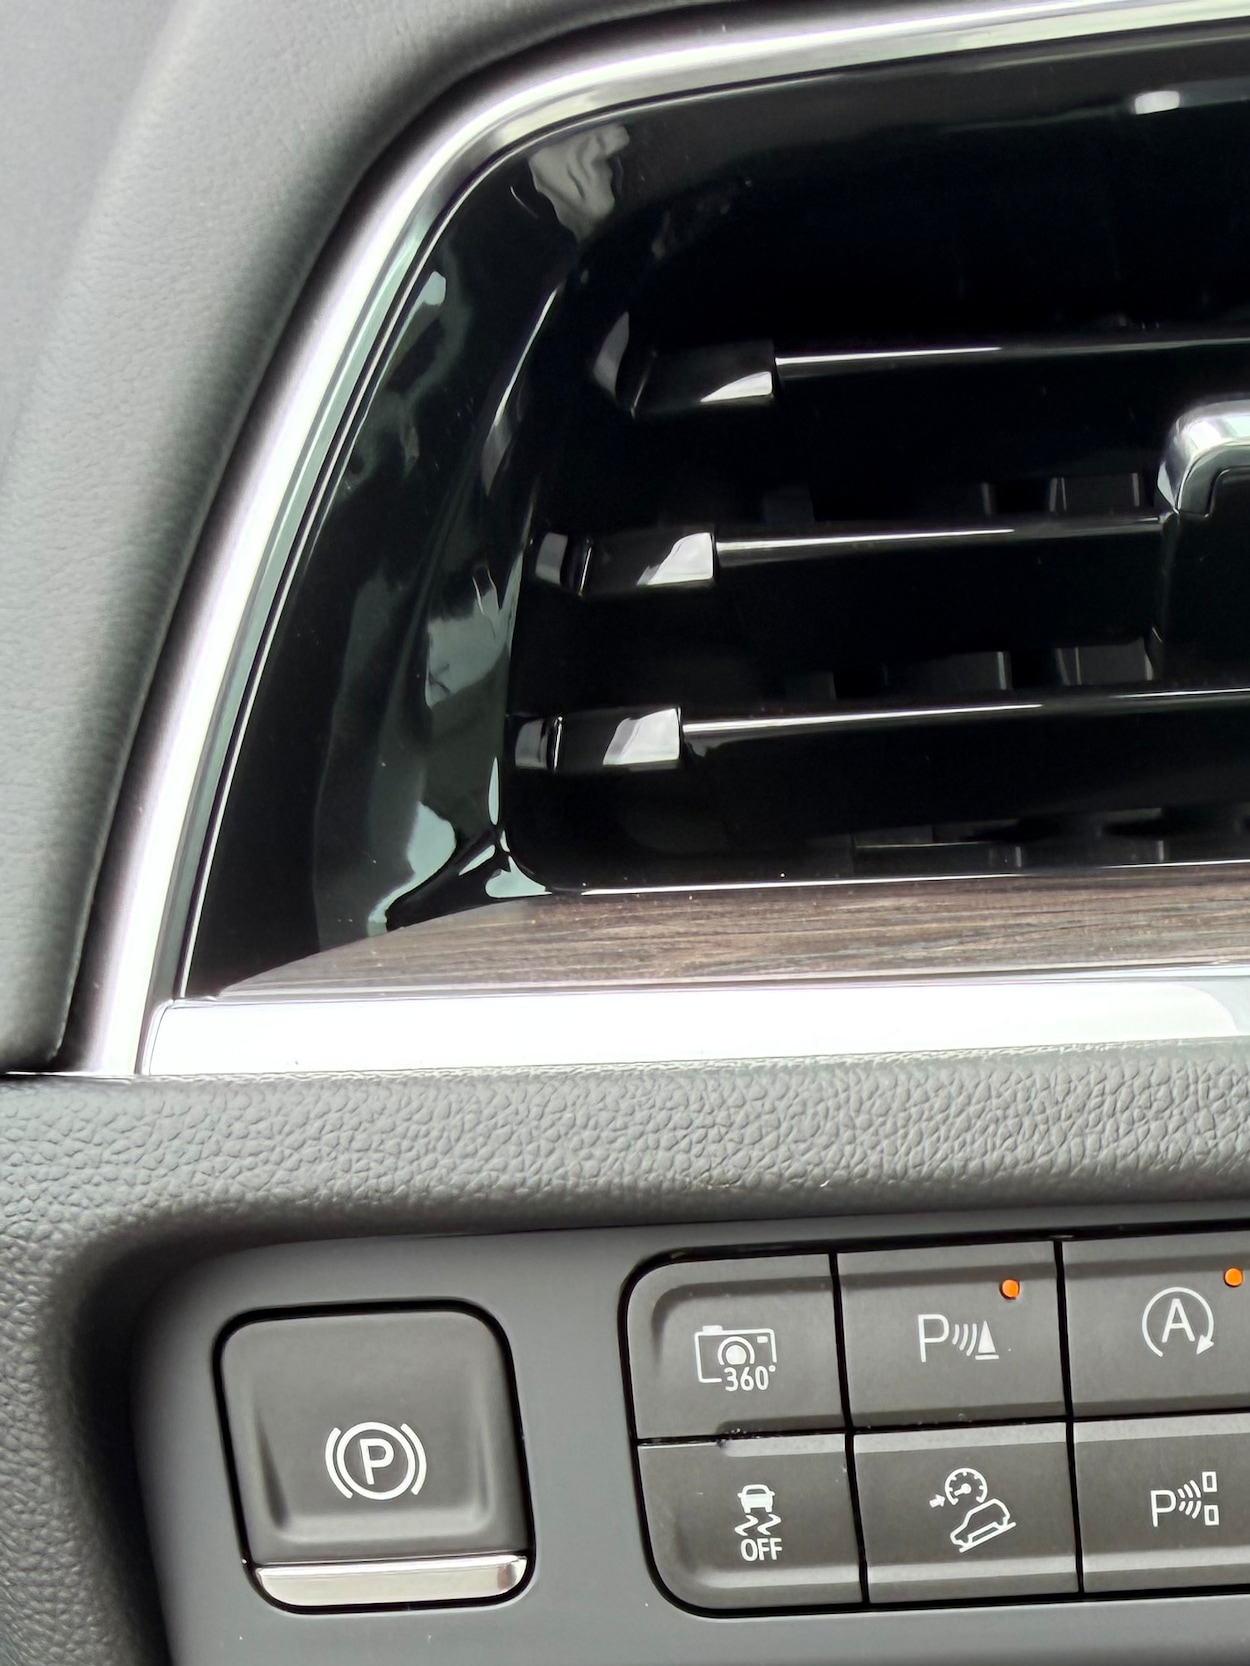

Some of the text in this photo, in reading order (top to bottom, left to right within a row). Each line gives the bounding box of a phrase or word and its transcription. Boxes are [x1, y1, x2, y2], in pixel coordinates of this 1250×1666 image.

[917, 1313, 950, 1363] P
[1161, 1298, 1196, 1343] A
[359, 1438, 395, 1485] P
[1150, 1489, 1177, 1528] P
[740, 1537, 783, 1562] OFF
